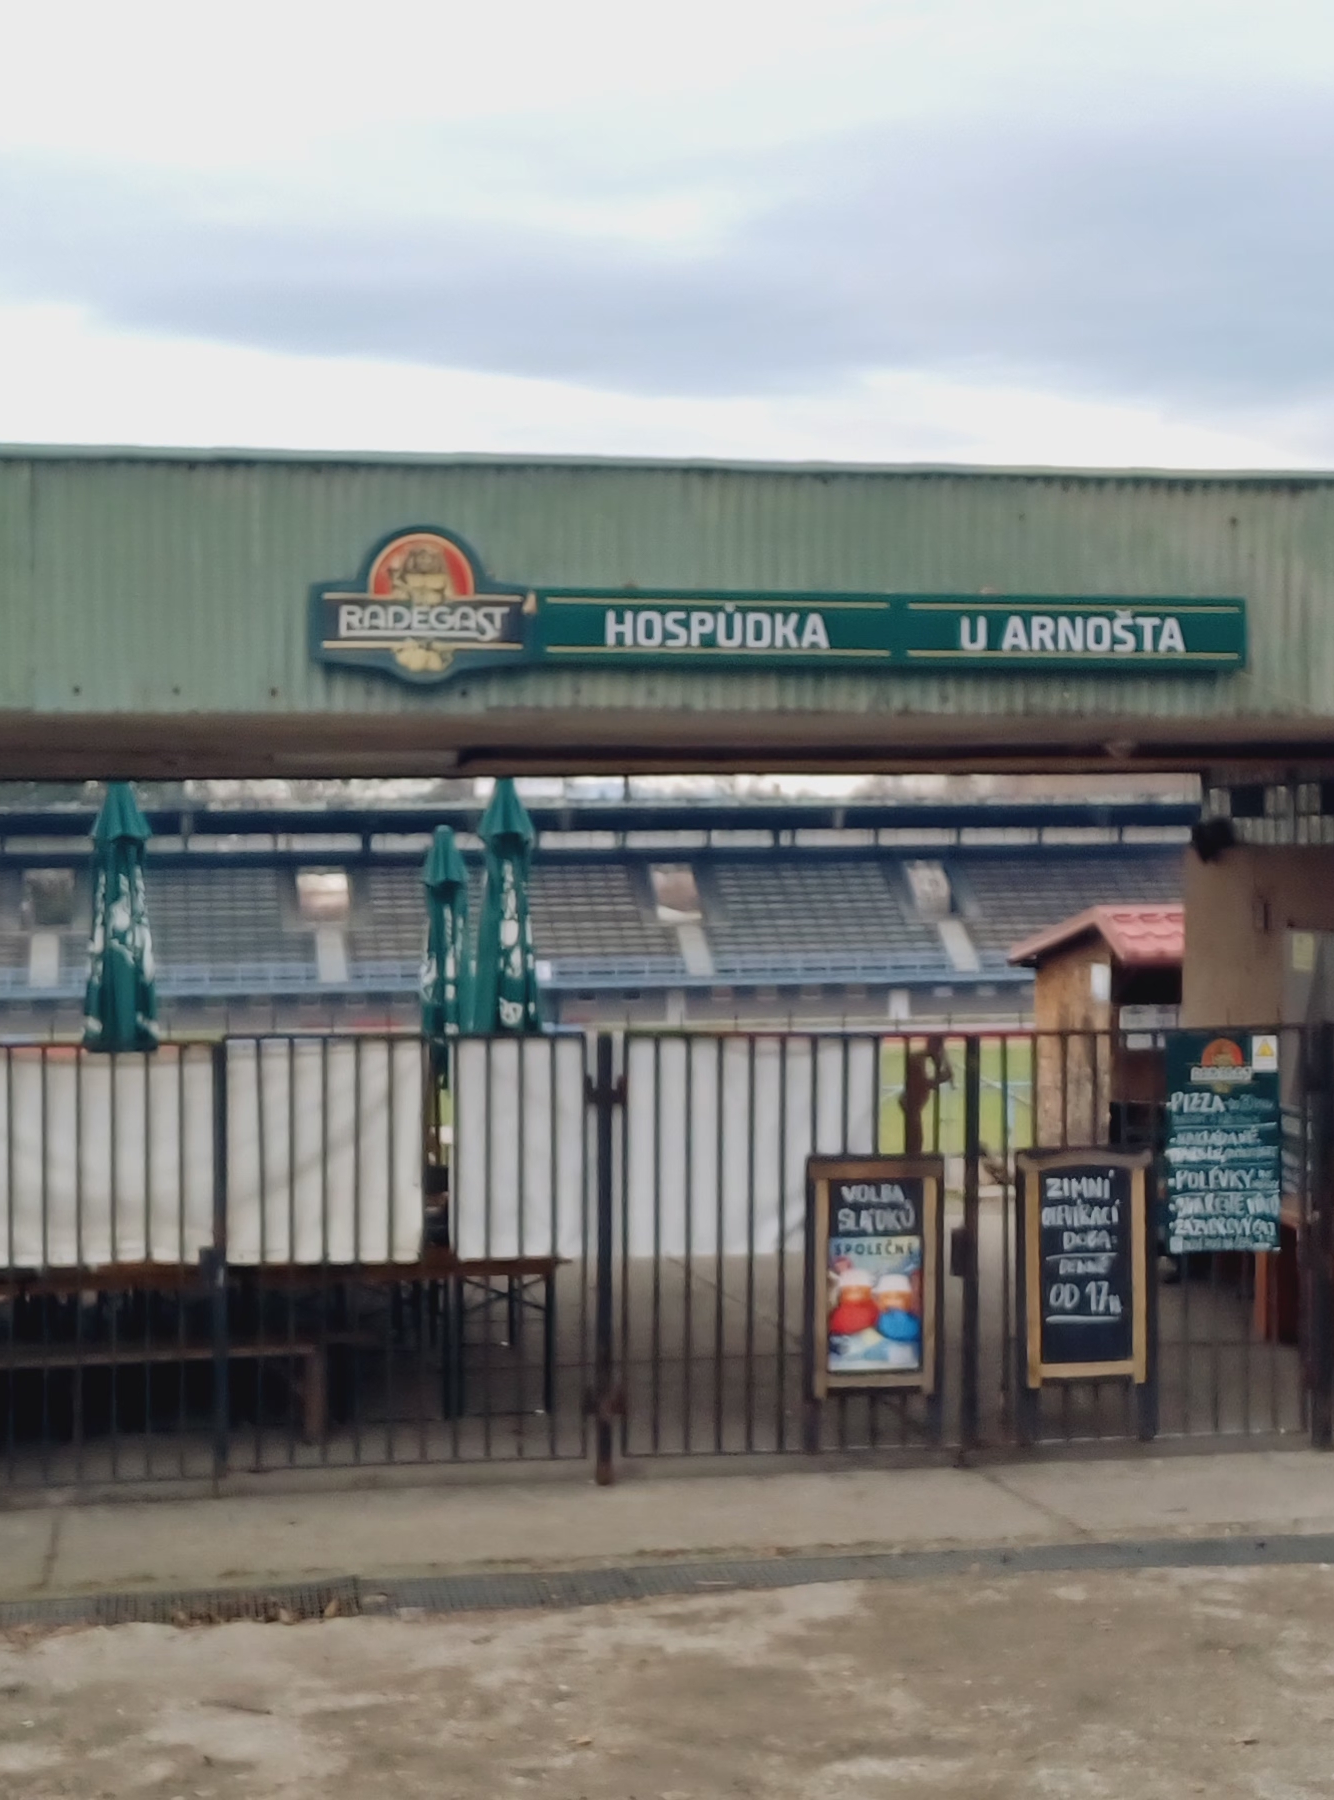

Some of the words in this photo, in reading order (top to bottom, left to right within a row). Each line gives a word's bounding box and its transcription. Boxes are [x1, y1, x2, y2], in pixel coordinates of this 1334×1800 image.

[339, 605, 509, 641] RADEGAST
[604, 602, 830, 648] HOSPŮDKA
[960, 615, 987, 651] U
[1001, 610, 1185, 653] ARNOŠTA
[1171, 1091, 1226, 1113] PIZZA
[1045, 1169, 1115, 1200] ZIMNÍ
[1049, 1283, 1080, 1309] OD
